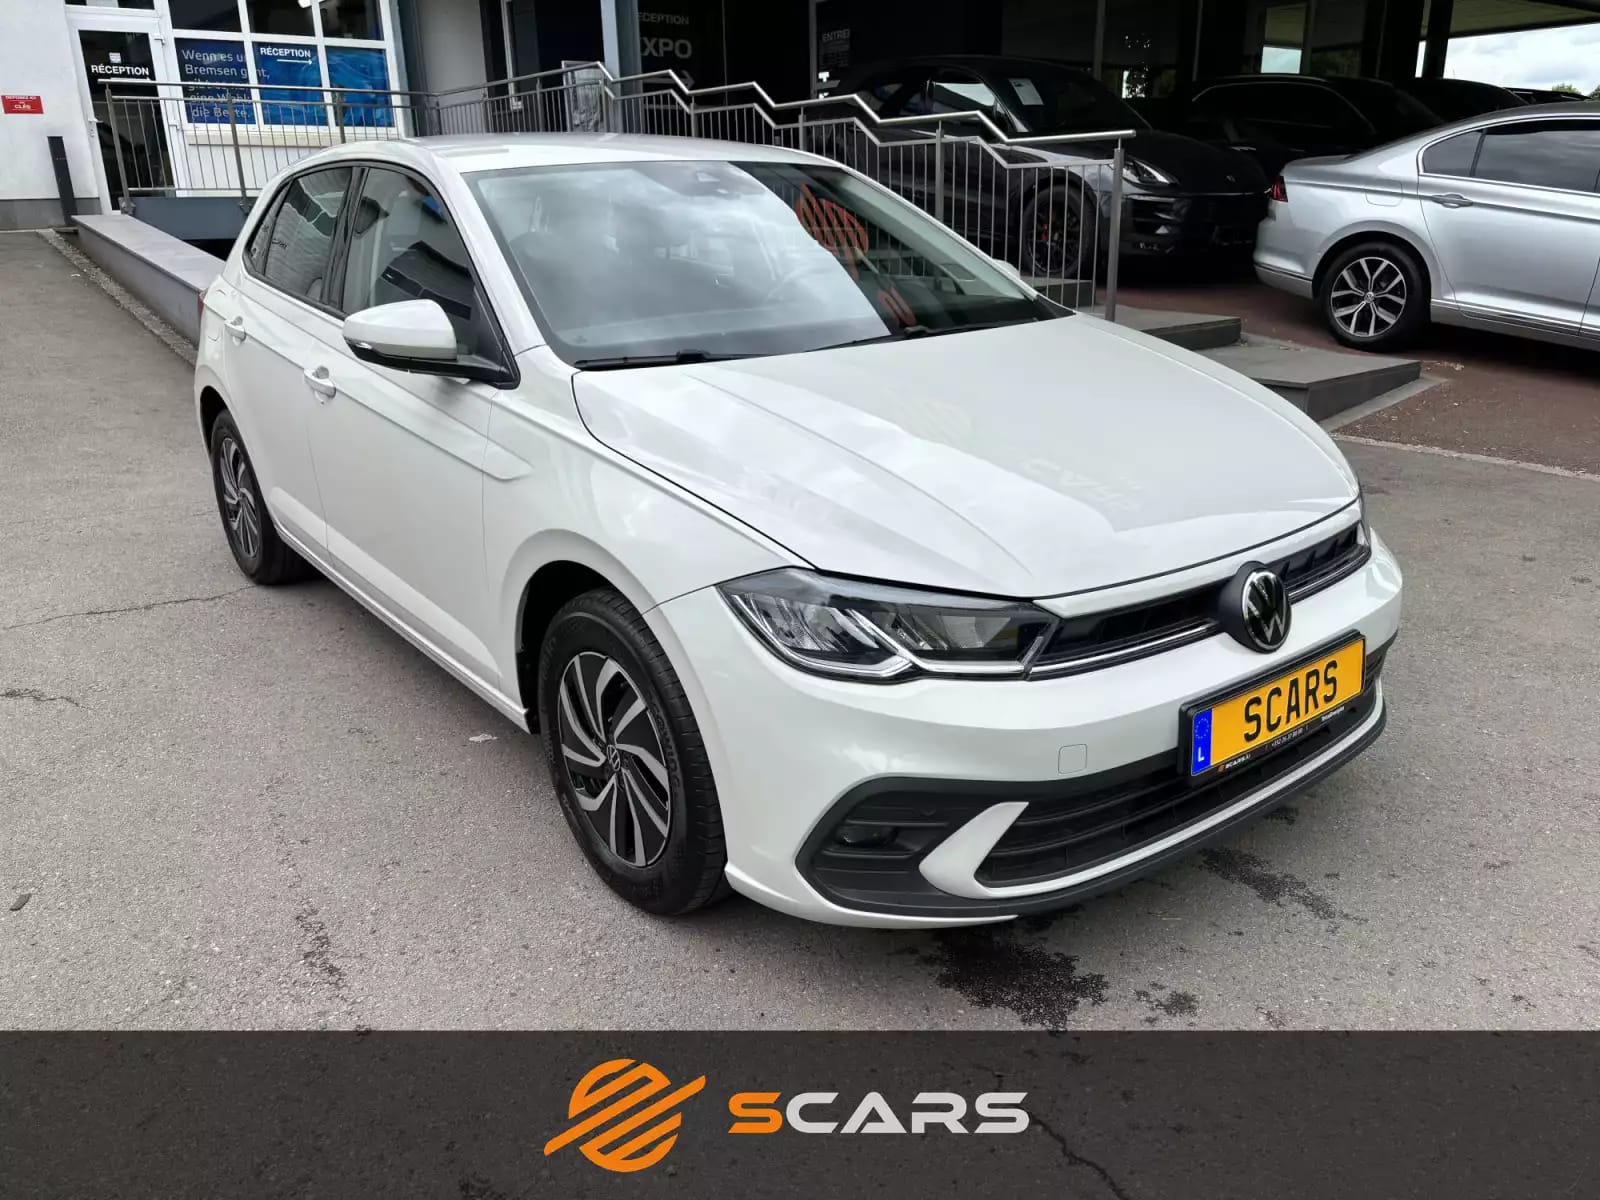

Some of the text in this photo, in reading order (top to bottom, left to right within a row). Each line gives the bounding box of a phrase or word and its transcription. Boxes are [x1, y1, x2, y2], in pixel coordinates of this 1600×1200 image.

[260, 45, 312, 58] RÉCEPTION
[640, 37, 693, 59] XPO
[182, 49, 217, 61] Wenn
[220, 53, 233, 62] es
[90, 63, 150, 76] RÉCEPTION
[184, 64, 270, 80] Bremsen gt,
[214, 107, 251, 118] Bete.
[1243, 659, 1338, 743] SCARS
[1197, 747, 1205, 762] L
